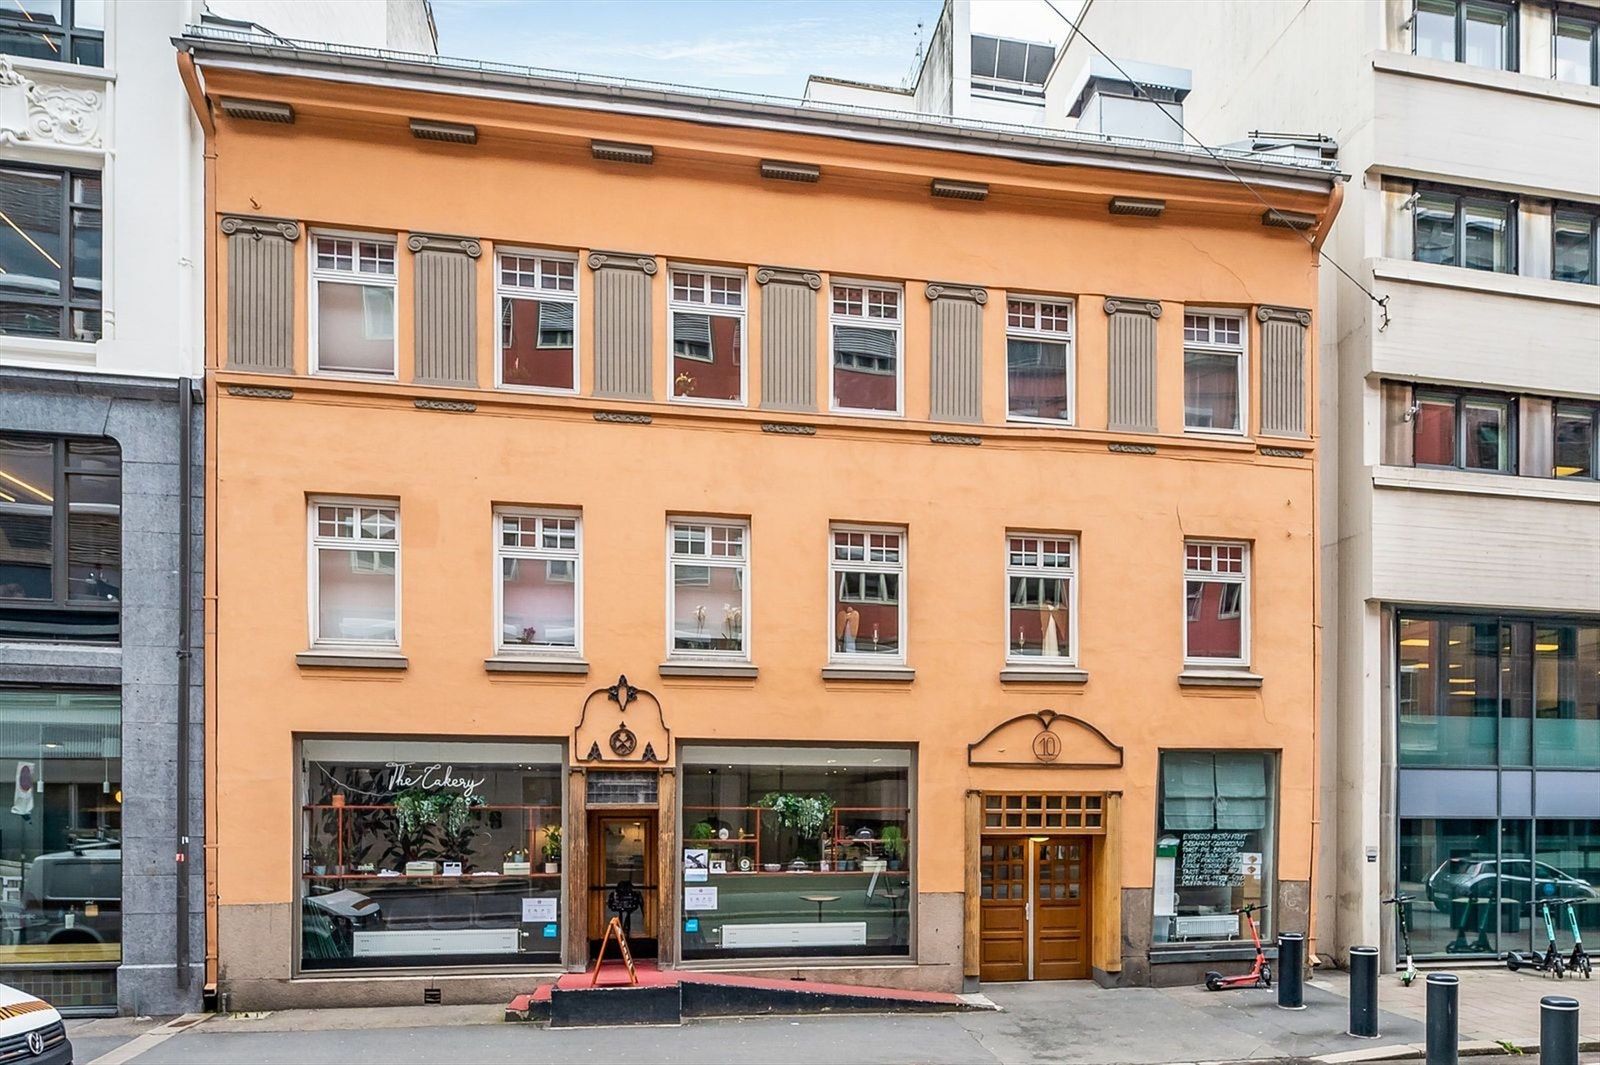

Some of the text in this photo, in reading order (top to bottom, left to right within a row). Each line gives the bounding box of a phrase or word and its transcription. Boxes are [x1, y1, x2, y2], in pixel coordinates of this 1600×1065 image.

[1039, 737, 1056, 756] 10
[385, 761, 485, 796] The Cakery
